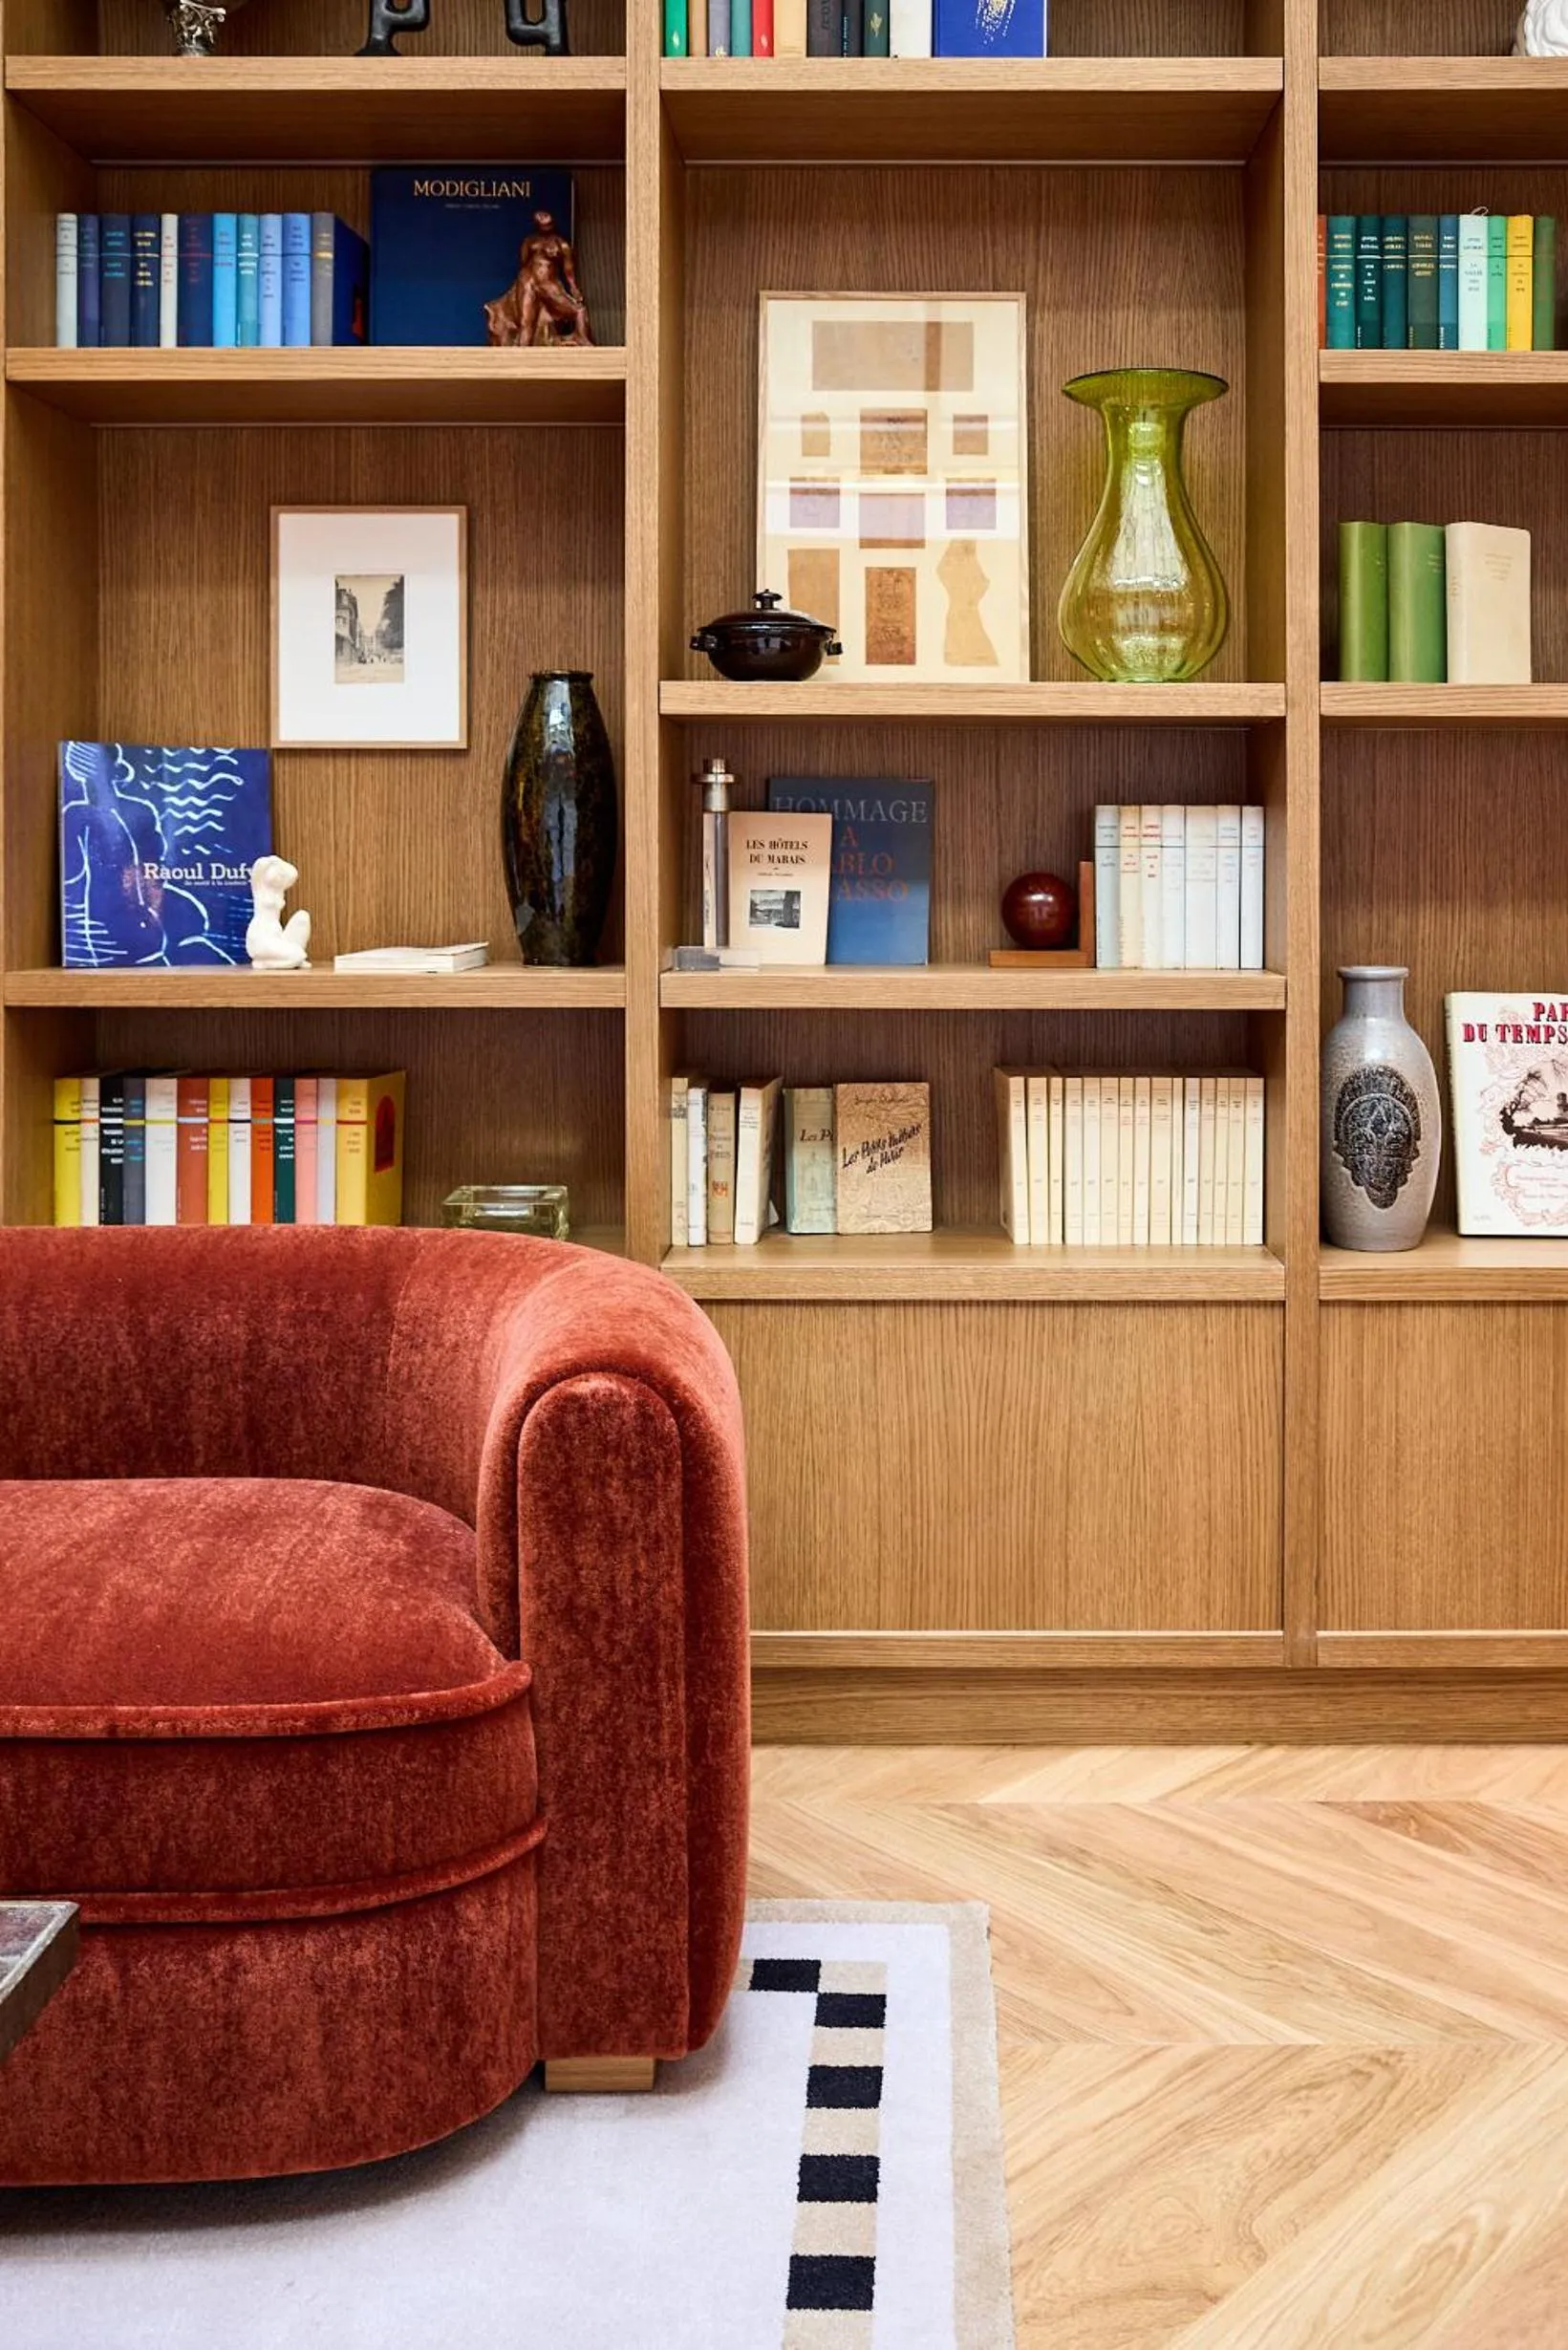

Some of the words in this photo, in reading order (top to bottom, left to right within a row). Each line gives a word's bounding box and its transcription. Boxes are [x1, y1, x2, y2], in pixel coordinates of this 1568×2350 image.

[414, 179, 530, 197] MODIGLIANI
[775, 796, 927, 823] HOMMAGE
[746, 839, 765, 850] LES
[768, 837, 808, 850] HÔTELS
[749, 853, 763, 864] DU
[767, 854, 806, 864] MARAIS
[837, 852, 895, 876] BLO
[143, 863, 204, 880] Raoul
[836, 877, 909, 902] ASSO
[1462, 1023, 1488, 1043] DU
[1495, 1024, 1568, 1045] TEMPS
